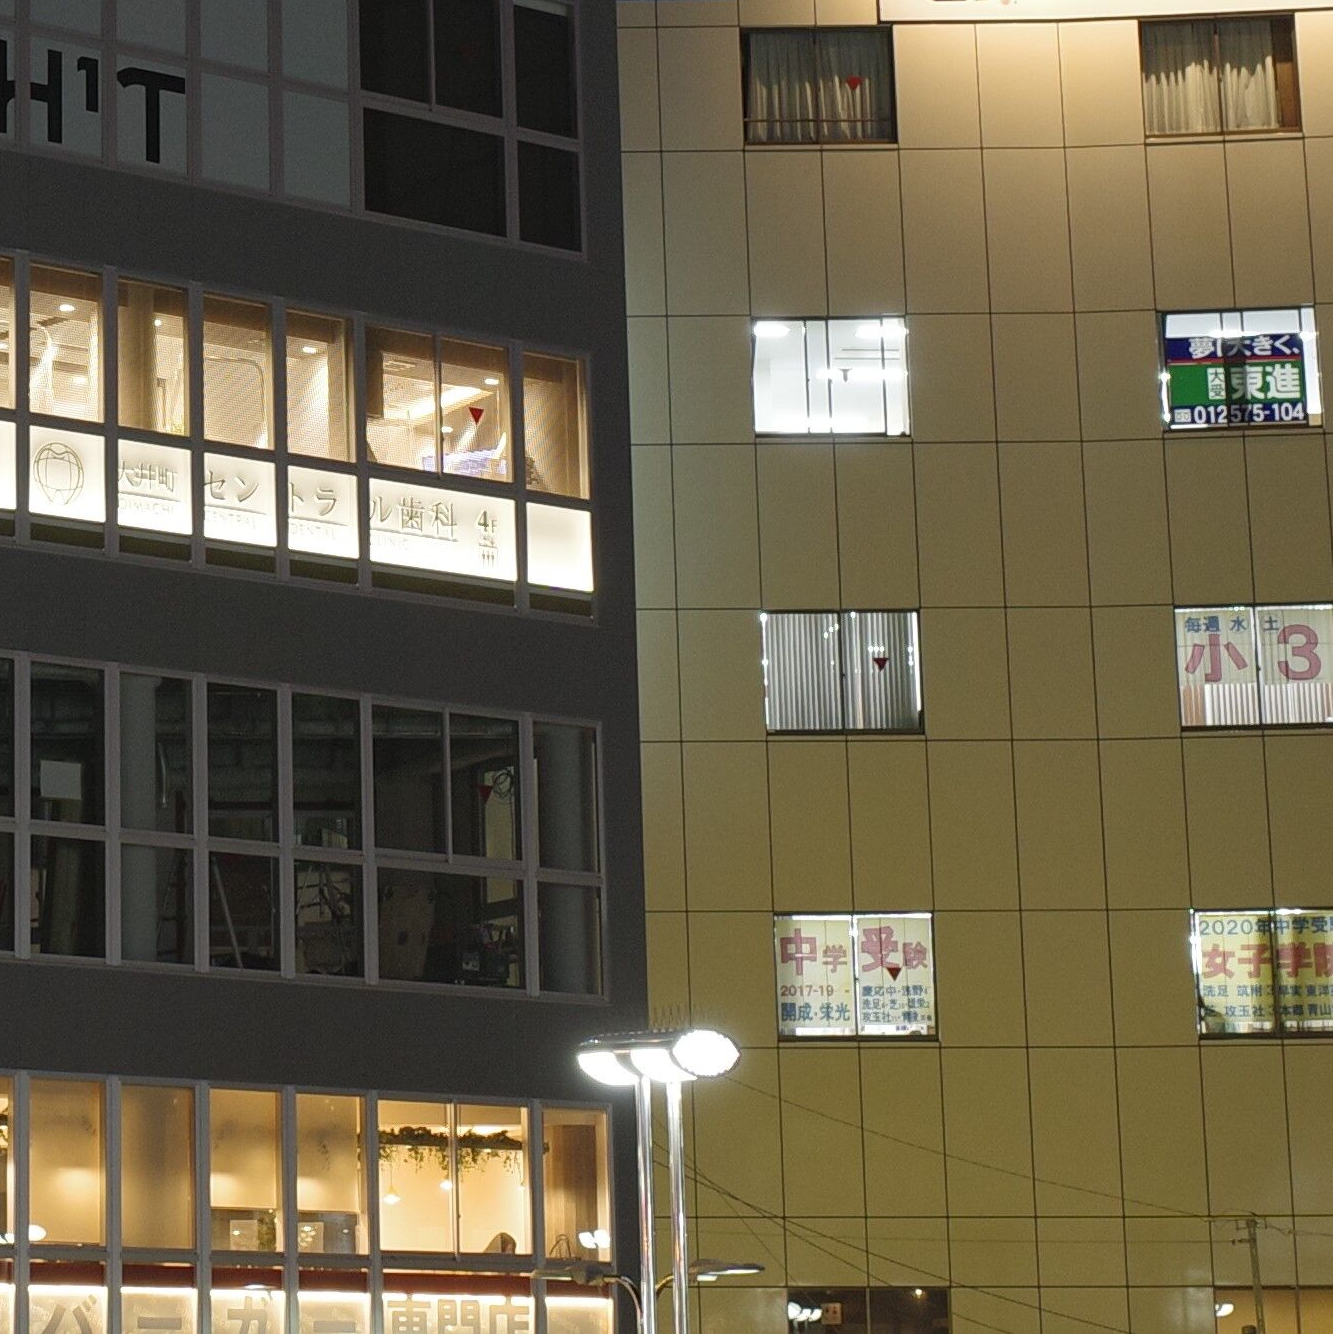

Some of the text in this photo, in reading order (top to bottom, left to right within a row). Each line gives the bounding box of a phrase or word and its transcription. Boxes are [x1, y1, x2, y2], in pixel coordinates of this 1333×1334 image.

[1230, 363, 1301, 400] 東進
[1185, 615, 1280, 634] 毎週 水 土
[1199, 917, 1333, 935] 2020年中学受
[780, 926, 928, 976] 中学受験
